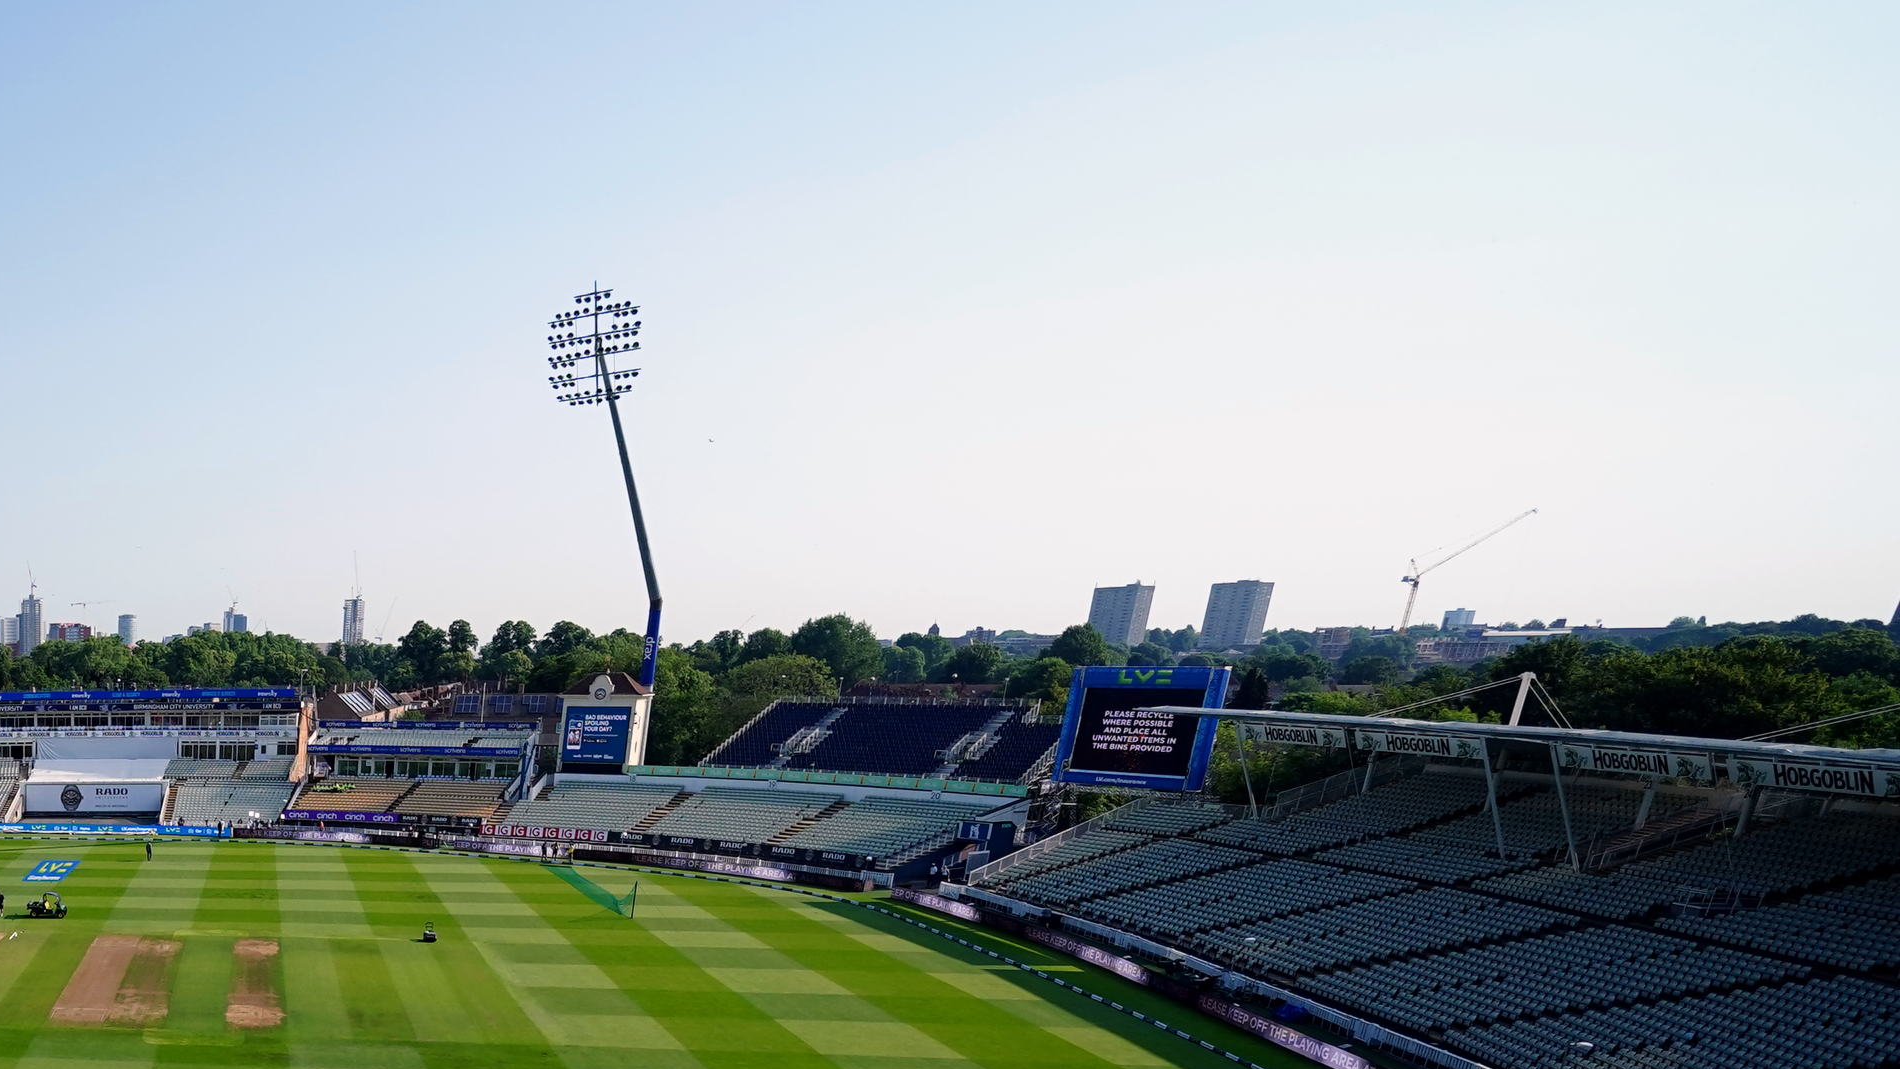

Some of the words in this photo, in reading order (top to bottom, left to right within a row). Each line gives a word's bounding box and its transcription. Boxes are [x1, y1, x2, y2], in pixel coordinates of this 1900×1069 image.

[644, 637, 655, 660] drax
[257, 690, 278, 698] intercity
[1137, 711, 1174, 719] RECYCLE
[1140, 736, 1165, 744] ITEMS
[1264, 726, 1317, 745] HOBGOBLIN
[1130, 744, 1172, 752] PROVIDED
[1386, 734, 1450, 755] HOBGOBLIN
[1593, 749, 1669, 776] HOBGOBLIN
[629, 774, 637, 783] 18
[1096, 777, 1146, 785] LV.com/insurance
[1773, 764, 1875, 794] HOBGOBLIN
[768, 779, 777, 789] 19
[95, 788, 128, 796] RADO
[930, 791, 942, 800] 20
[289, 811, 309, 819] cinch
[317, 812, 337, 820] cinch
[345, 813, 365, 821] cinch
[373, 814, 393, 822] cinch
[482, 825, 494, 835] IG
[498, 825, 509, 835] IG
[513, 826, 524, 836] IG
[529, 827, 540, 837] IG
[545, 828, 557, 838] IG
[561, 829, 572, 839] IG
[577, 829, 589, 839] IG
[594, 830, 605, 840] IG
[621, 832, 642, 842] RADO
[671, 837, 694, 846] RADO
[720, 841, 742, 850] RADO
[772, 847, 794, 856] RADO
[822, 852, 845, 861] RADO
[665, 857, 686, 867] KEEP
[688, 860, 705, 868] OFF
[707, 861, 723, 871] THE
[725, 863, 759, 875] PLAYING
[762, 868, 785, 879] AREA
[905, 890, 918, 900] OFF
[919, 894, 931, 904] THE
[932, 896, 956, 912] PLAYING
[957, 905, 973, 918] AREA
[1050, 934, 1067, 949] KEEP
[1068, 940, 1081, 952] OFF
[1082, 947, 1094, 961] THE
[1095, 951, 1122, 971] PLAYING
[1124, 961, 1141, 979] AREA
[1198, 996, 1226, 1017] PLEASE
[1227, 1007, 1249, 1025] KEEP
[1250, 1017, 1268, 1033] OFF
[1270, 1024, 1288, 1044] THE
[1289, 1032, 1330, 1060] PLAYING
